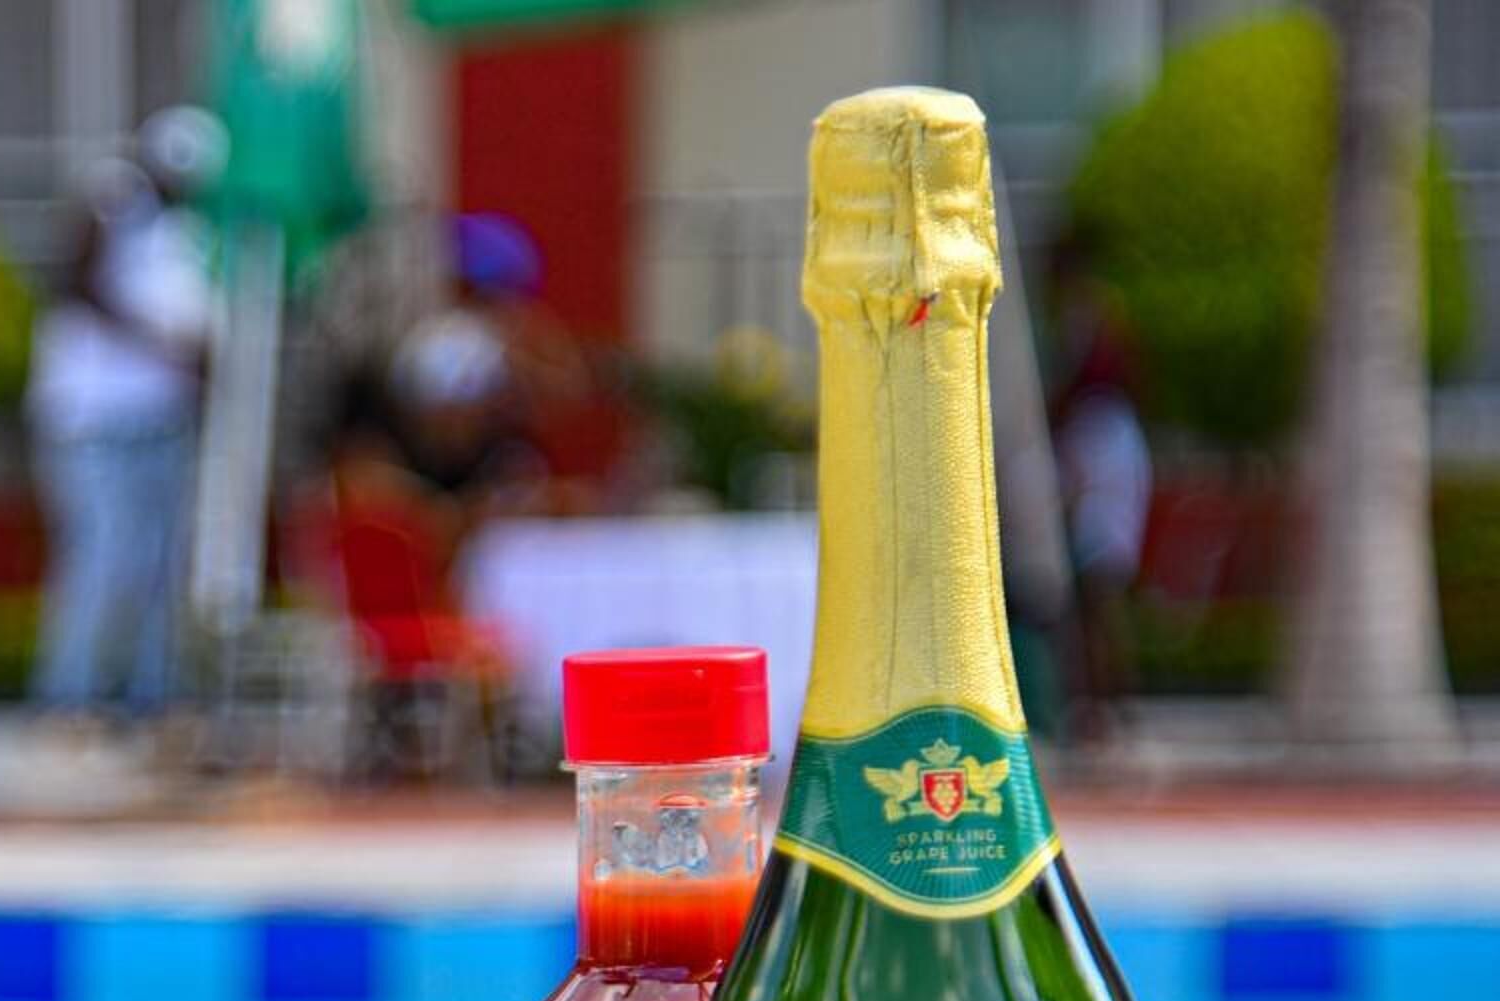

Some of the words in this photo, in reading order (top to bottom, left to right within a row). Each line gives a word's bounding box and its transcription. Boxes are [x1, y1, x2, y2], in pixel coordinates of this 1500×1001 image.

[897, 829, 997, 846] SPARKLING
[889, 846, 949, 864] GRAPE
[959, 845, 1006, 860] JUICE
